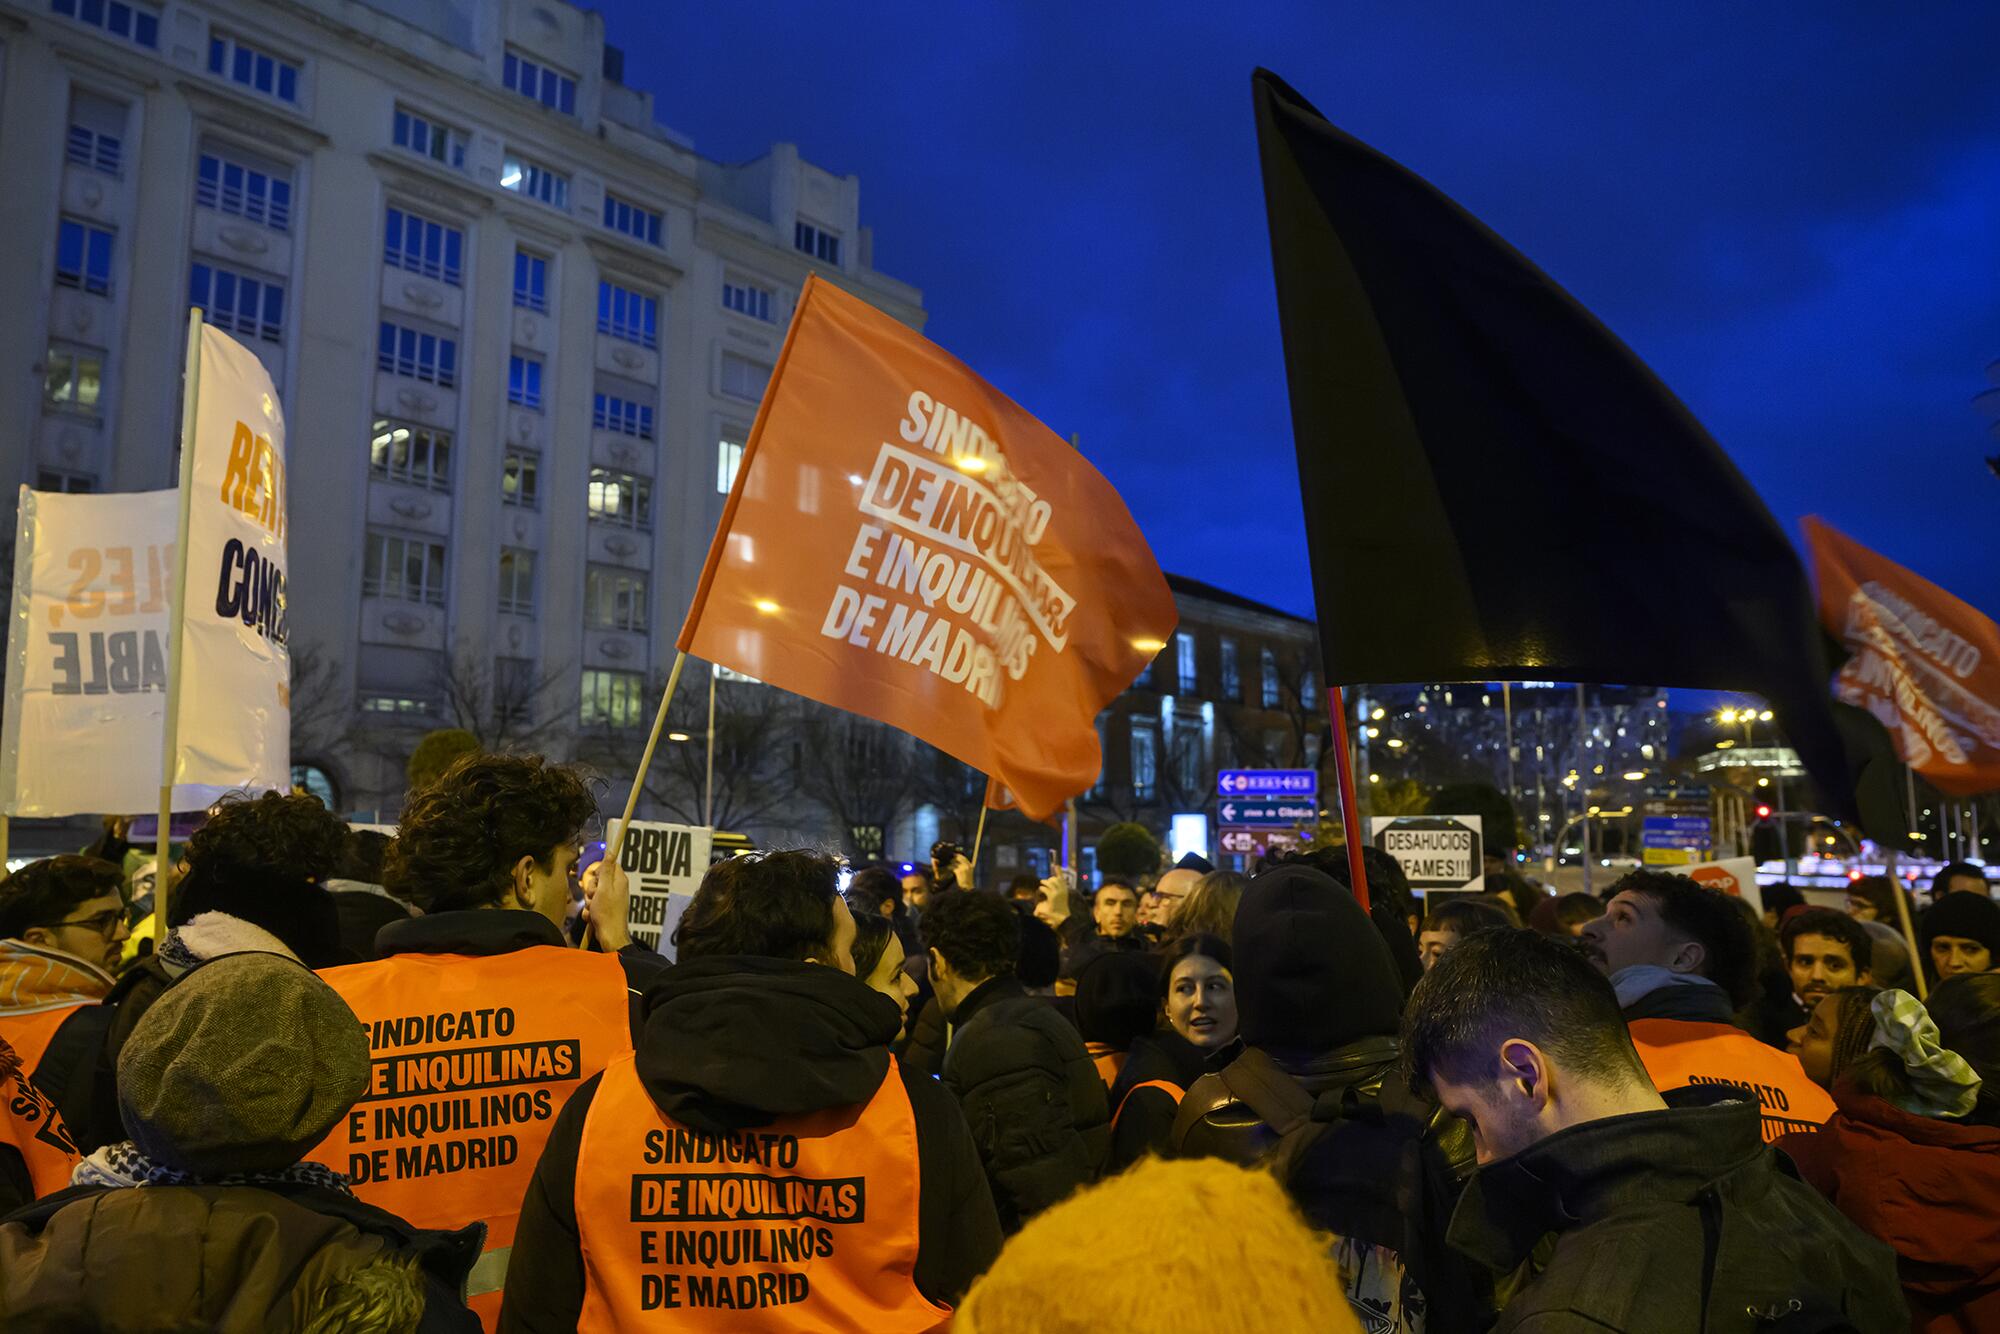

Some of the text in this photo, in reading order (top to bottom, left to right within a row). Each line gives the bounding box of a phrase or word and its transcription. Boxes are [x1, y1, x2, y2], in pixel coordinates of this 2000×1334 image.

[900, 390, 1052, 546] SINDTO
[871, 456, 1065, 639] DE INQUS
[845, 523, 1037, 681] E INQUILOS
[821, 584, 1004, 710] DE MADRI
[621, 828, 692, 877] BBVA
[1388, 833, 1470, 850] DESAHUCIOS
[1400, 859, 1471, 877] FAMES!!!
[396, 1044, 573, 1092] INQUILINAS
[349, 1089, 552, 1144] E INQUILINOS
[349, 1134, 518, 1186] DE MADRID
[644, 1128, 799, 1169] SINDICATO
[640, 1178, 858, 1220] DE INQUILINAS
[640, 1225, 834, 1270] E INQUILINOS
[641, 1272, 810, 1312] DE MADRID
